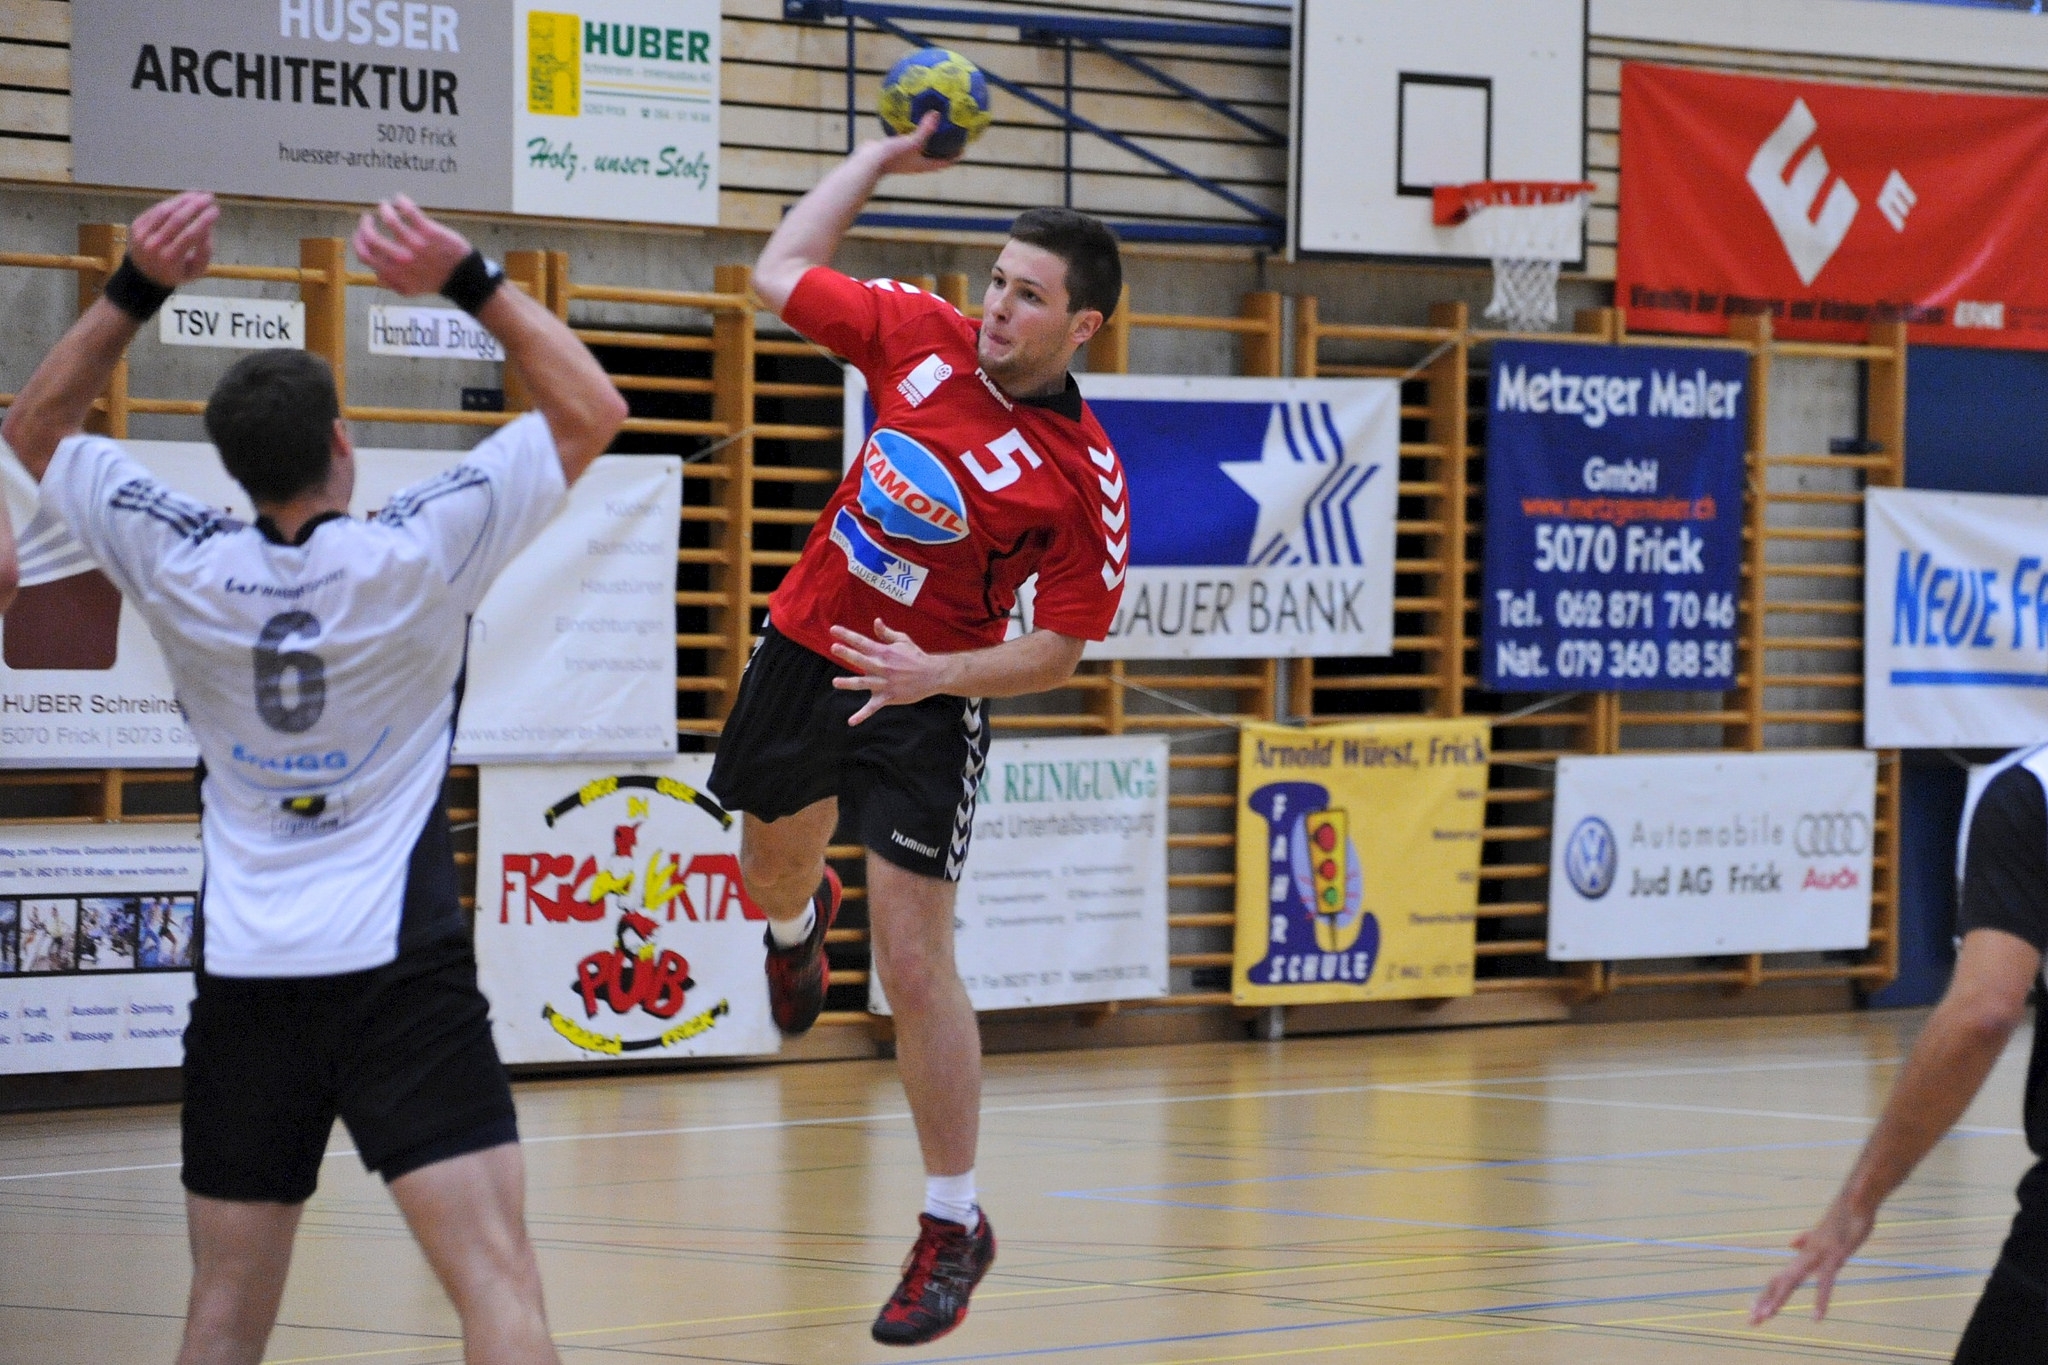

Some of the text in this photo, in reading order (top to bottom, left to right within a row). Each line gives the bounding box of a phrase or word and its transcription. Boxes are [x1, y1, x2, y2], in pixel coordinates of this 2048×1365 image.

[584, 20, 711, 64] HUBER
[131, 44, 459, 116] ARCHITEKTUR
[377, 123, 457, 148] 5070 Frick
[278, 141, 458, 174] huesser-architektur.ch
[594, 156, 650, 175] unser
[656, 146, 710, 190] Stolz
[174, 309, 290, 340] TSV Frick
[373, 315, 440, 348] Handball
[1498, 364, 1742, 428] Metzger Maler
[959, 427, 1043, 493] 5
[1582, 456, 1659, 493] GmbH
[865, 441, 964, 535] TAMOIL
[1534, 524, 1705, 575] 5070 Frick
[878, 576, 908, 601] BANK
[1893, 550, 1999, 649] NEUE
[1249, 581, 1365, 636] BANK
[1496, 589, 1736, 629] Tel. 062 871 70 46
[253, 610, 326, 735] 6
[1496, 639, 1549, 678] Nat.
[1556, 639, 1604, 678] 079
[1608, 640, 1660, 678] 360
[1665, 640, 1700, 678] 88
[3, 694, 181, 714] HUBER Schreine
[1, 727, 50, 745] 5070
[56, 727, 100, 745] Frick
[117, 727, 162, 745] 5073
[1257, 738, 1335, 768] Arnold
[1429, 736, 1485, 766] Frick
[1004, 757, 1143, 804] REINIGUNG
[891, 827, 940, 860] hummel
[1632, 812, 1785, 850] Automobile
[1630, 861, 1783, 896] Jud AG Frick
[1803, 865, 1859, 893] Audi
[577, 949, 689, 1019] PUB
[1268, 952, 1369, 983] SCHULE
